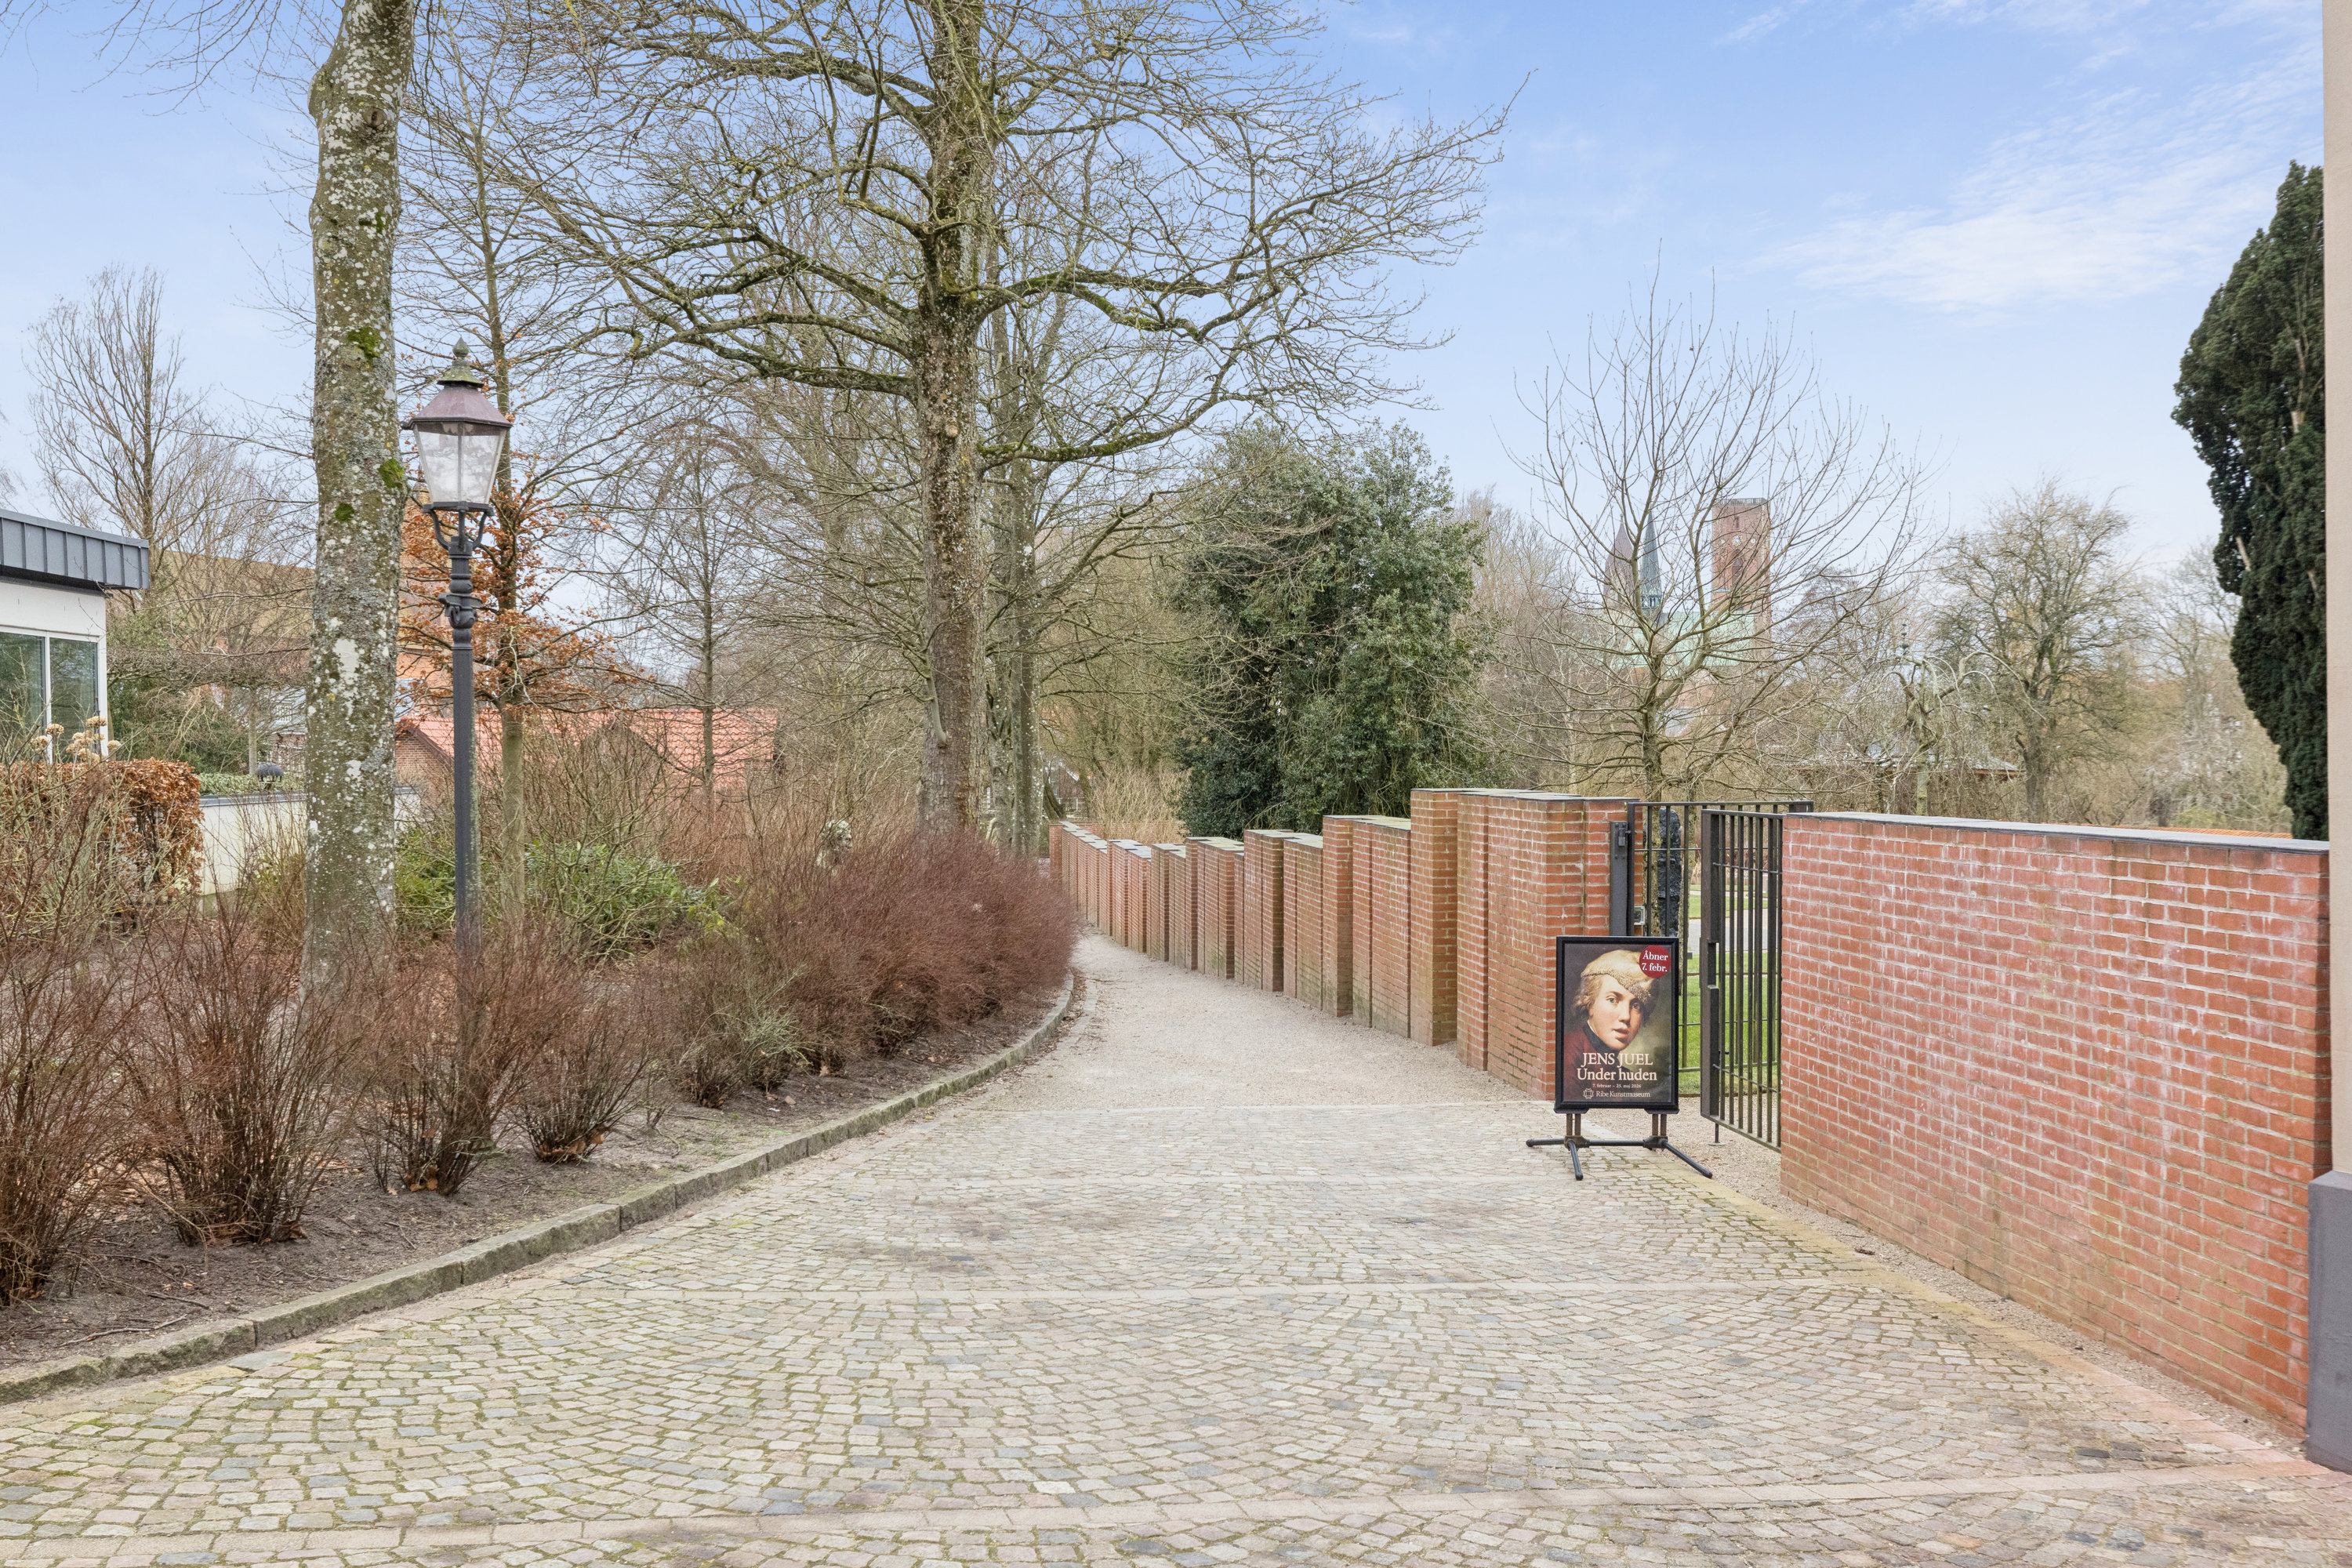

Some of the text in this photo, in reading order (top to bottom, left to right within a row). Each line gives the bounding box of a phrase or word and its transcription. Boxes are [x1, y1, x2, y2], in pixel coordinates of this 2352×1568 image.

[1642, 949, 1668, 961] Åbner
[1649, 963, 1668, 972] febr.
[1581, 1052, 1653, 1068] JENS JUEL
[1577, 1068, 1657, 1081] Under huden
